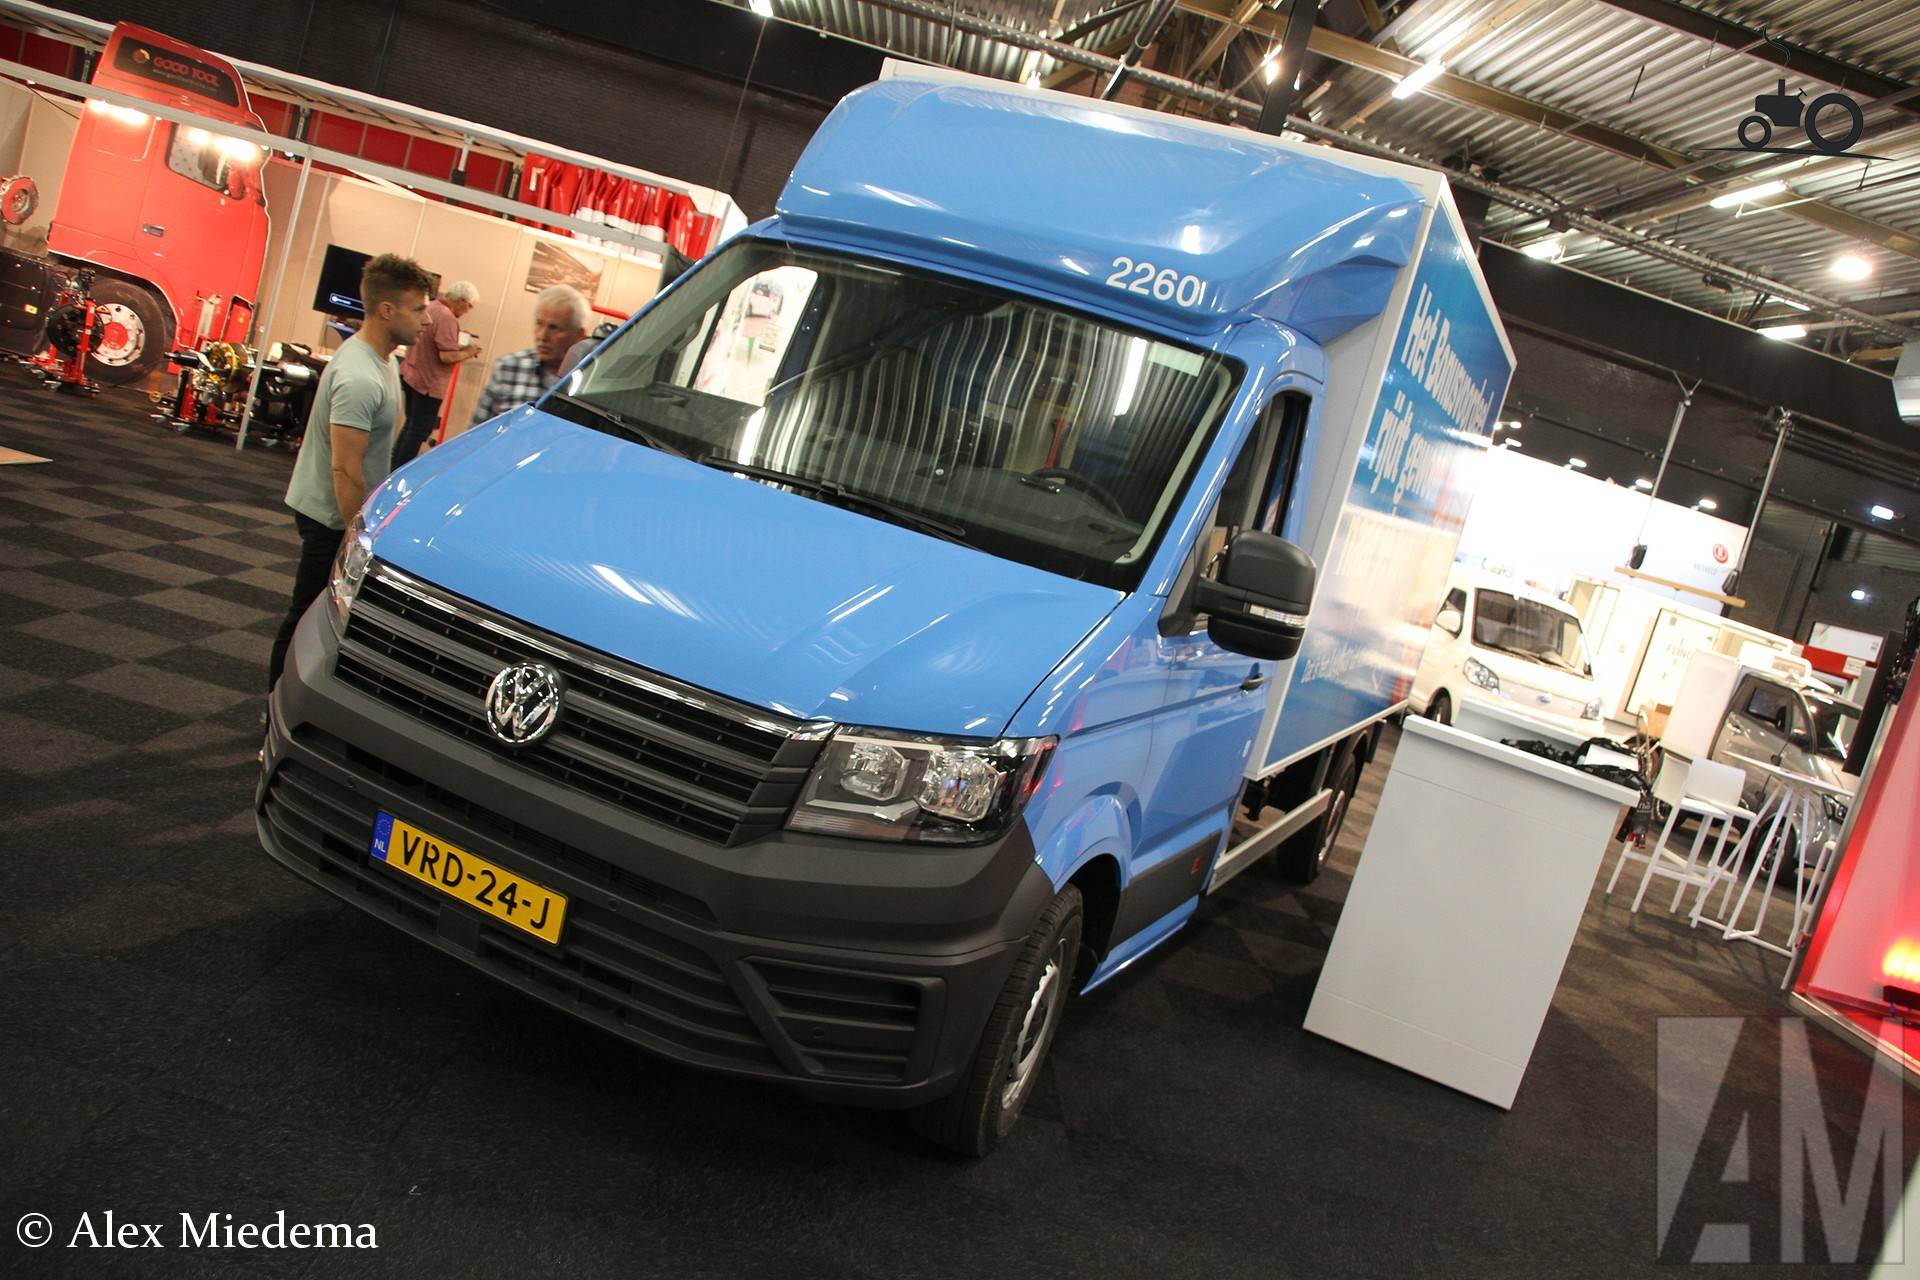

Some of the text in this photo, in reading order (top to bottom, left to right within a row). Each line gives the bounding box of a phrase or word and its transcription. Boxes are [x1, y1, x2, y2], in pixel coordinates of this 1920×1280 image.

[1105, 256, 1201, 307] 2260
[1401, 282, 1441, 384] Het
[1368, 390, 1414, 494] rijdt
[374, 838, 386, 854] NL
[402, 829, 550, 930] VRD-24-J
